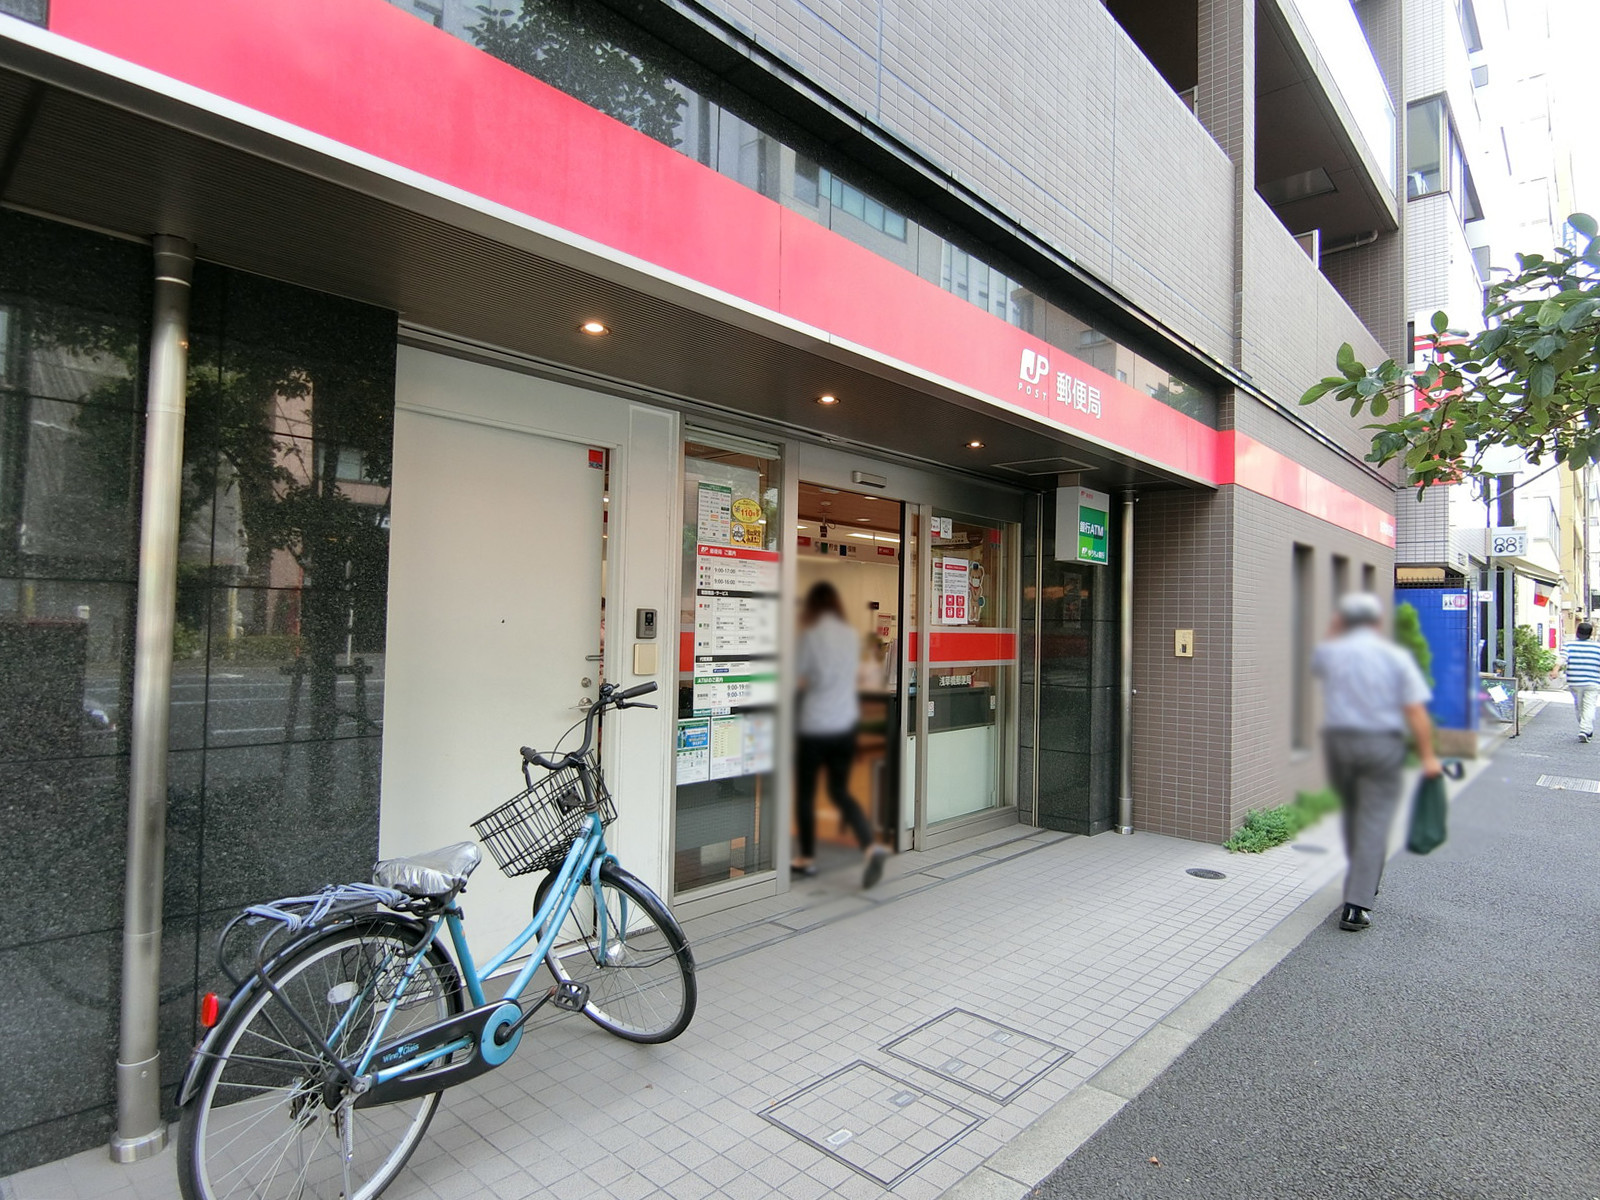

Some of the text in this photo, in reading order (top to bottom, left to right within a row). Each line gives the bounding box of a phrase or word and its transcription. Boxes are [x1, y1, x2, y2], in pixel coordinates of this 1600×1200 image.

[1018, 382, 1047, 401] POST
[1056, 371, 1102, 419] 郵便局
[1080, 521, 1104, 536] 銀行ATM
